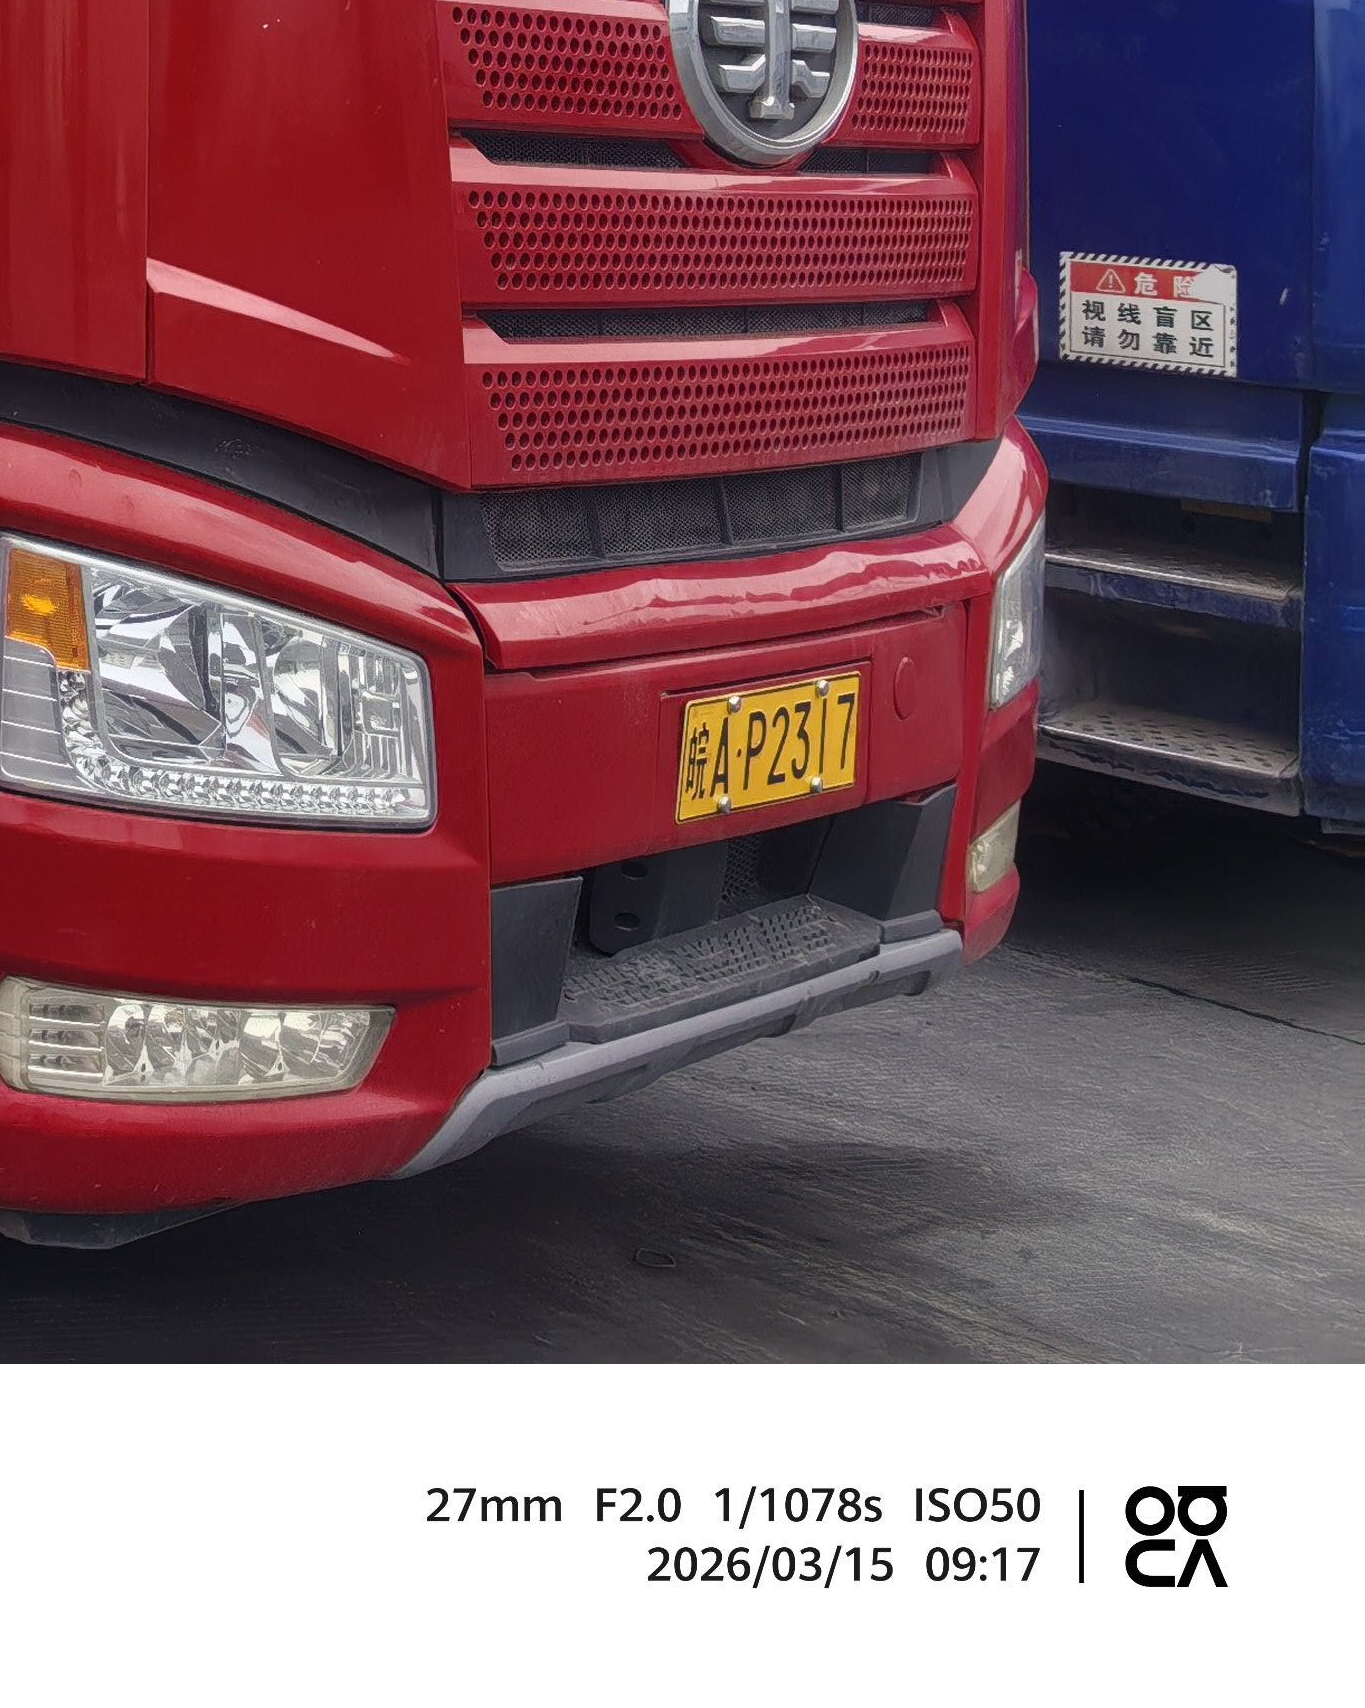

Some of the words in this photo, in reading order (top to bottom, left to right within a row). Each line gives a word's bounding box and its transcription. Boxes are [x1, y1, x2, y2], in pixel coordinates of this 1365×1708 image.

[1133, 272, 1196, 298] 危险
[1082, 300, 1214, 331] 视线盲区
[1081, 326, 1214, 358] 请勿靠近
